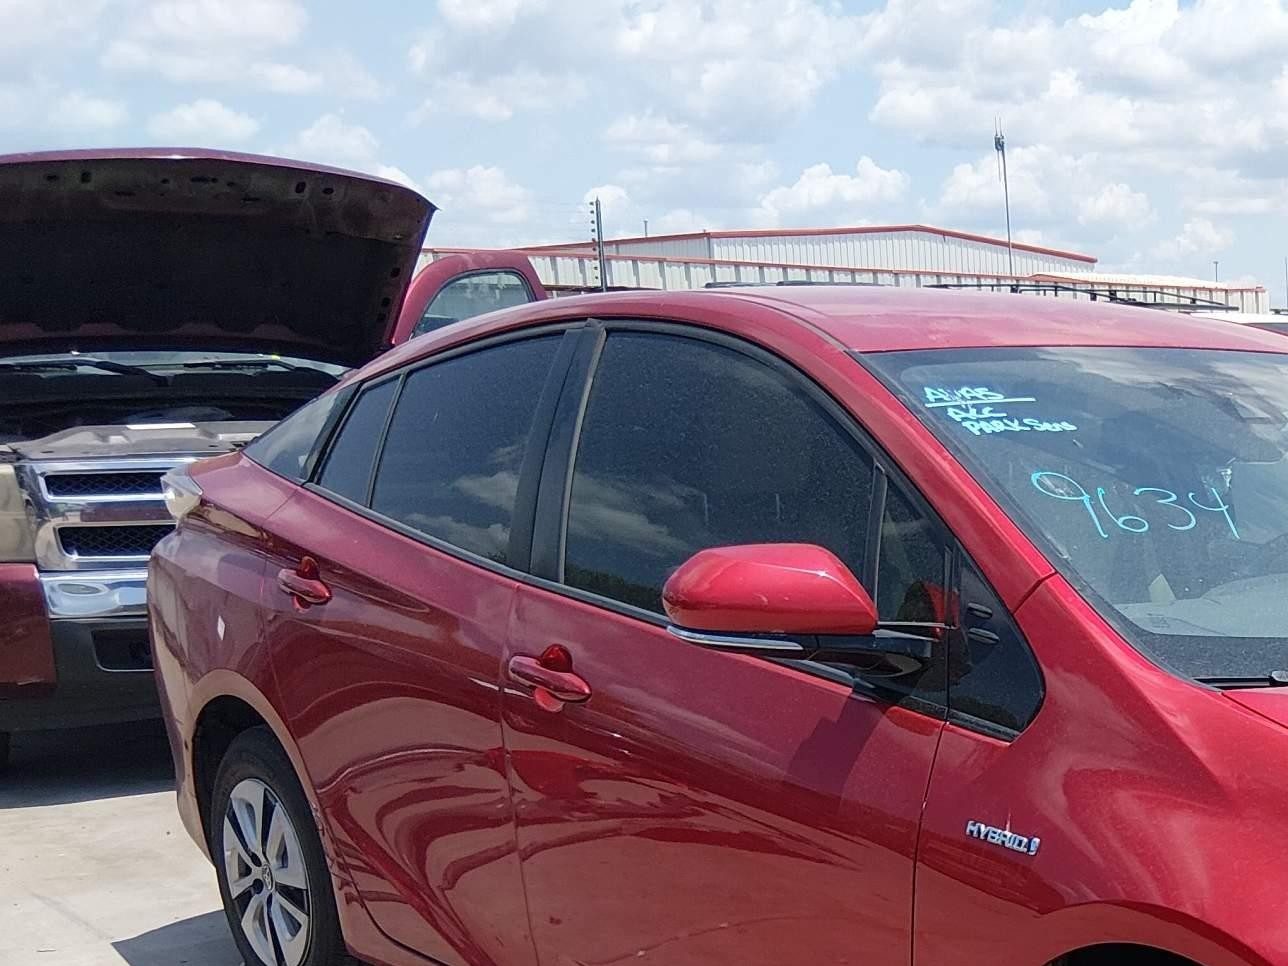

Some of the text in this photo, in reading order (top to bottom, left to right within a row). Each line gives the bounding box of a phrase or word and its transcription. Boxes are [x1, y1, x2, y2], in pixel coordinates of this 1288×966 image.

[962, 419, 1031, 435] PARK
[1031, 472, 1240, 539] 9634
[966, 820, 1028, 853] HYBRID
